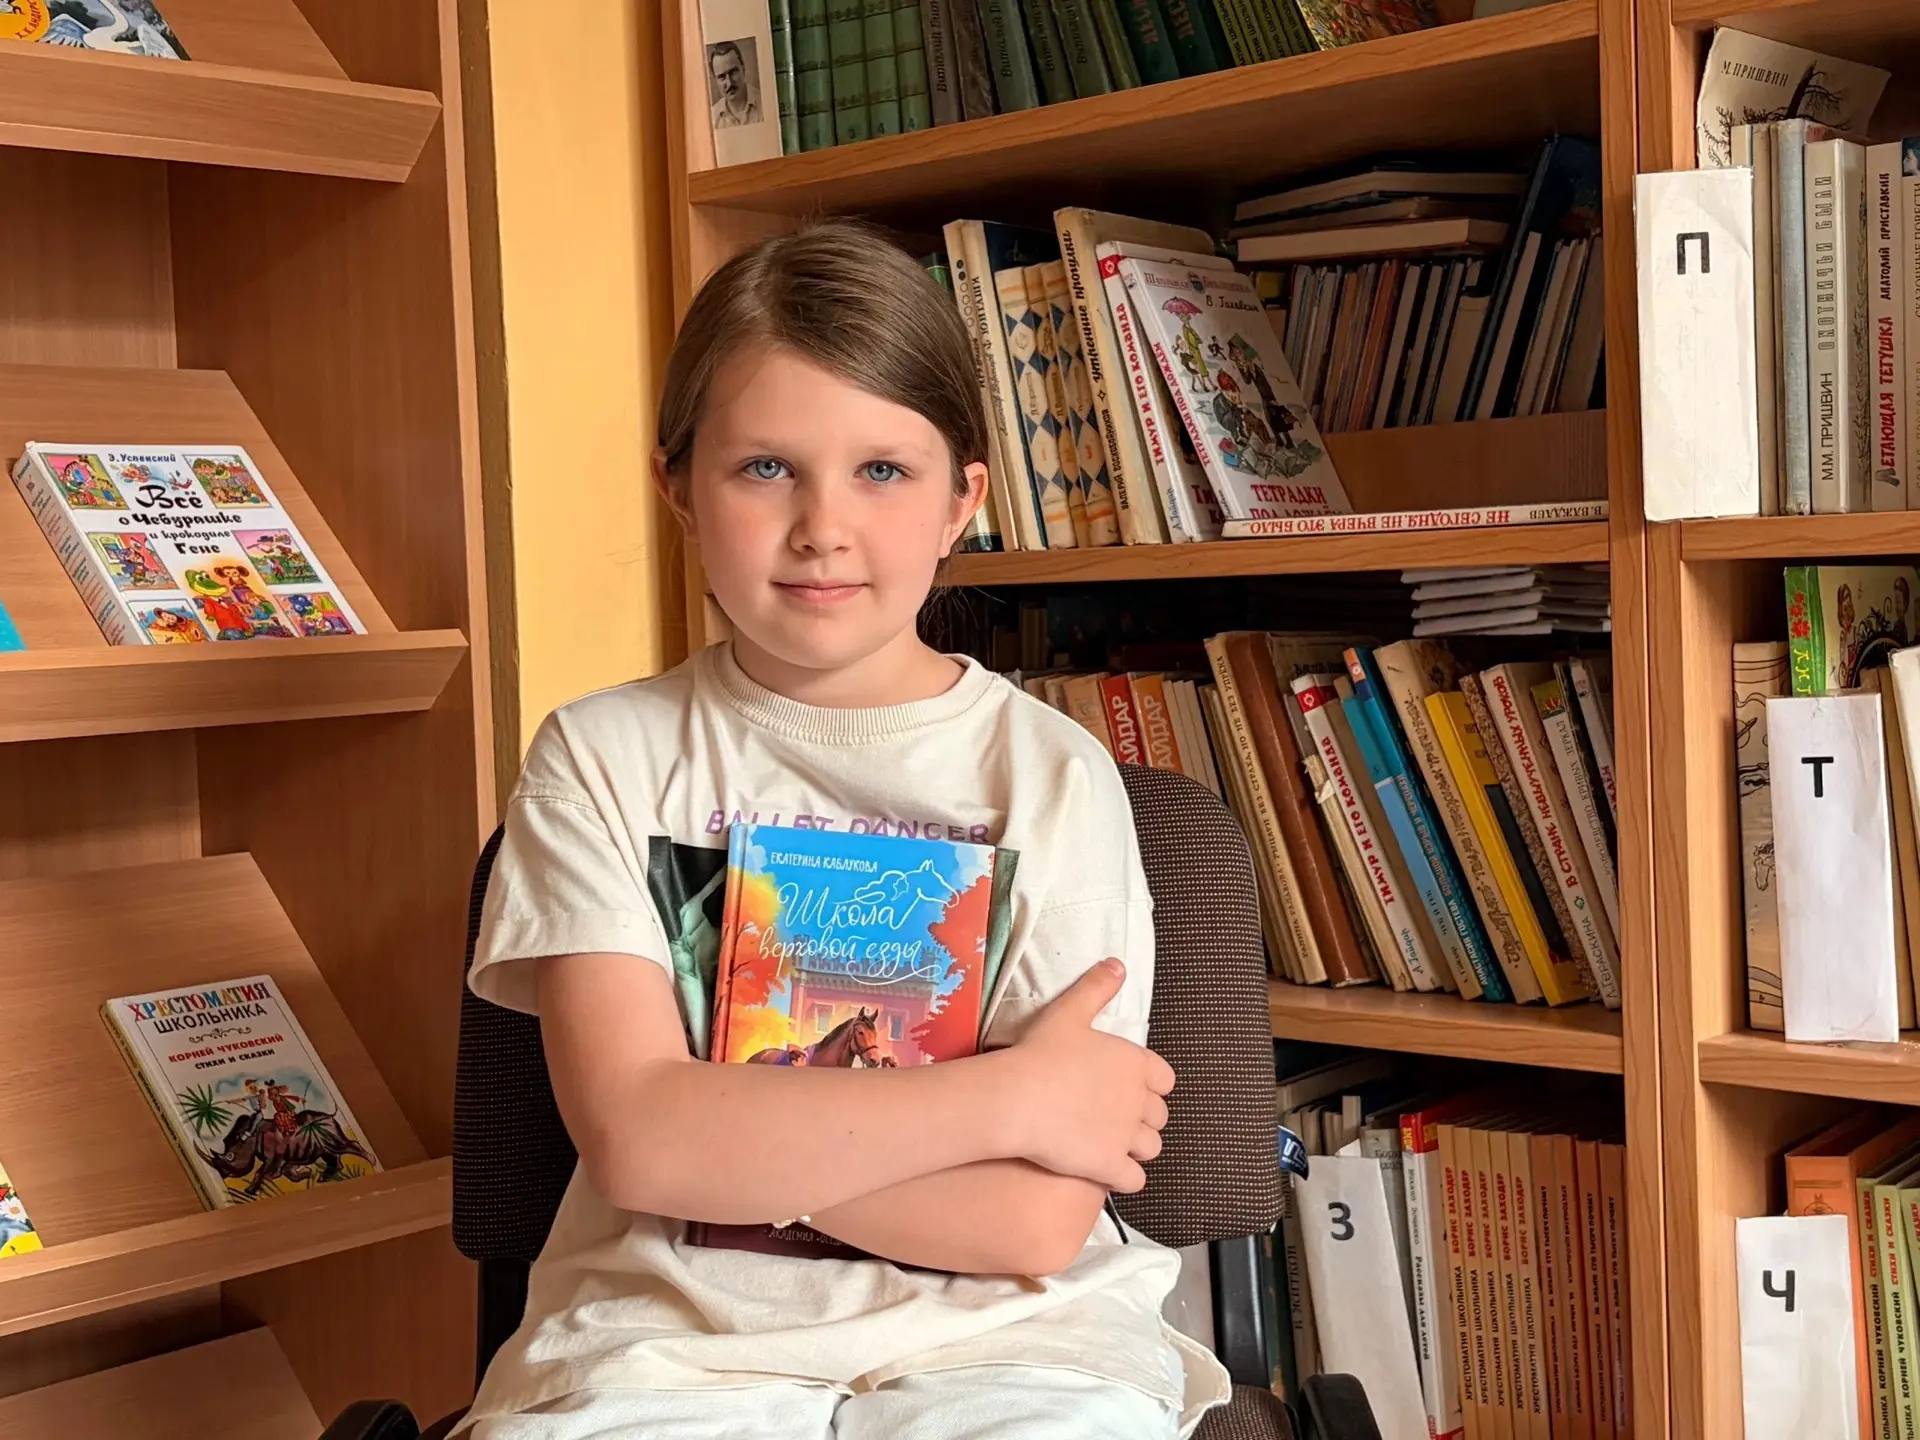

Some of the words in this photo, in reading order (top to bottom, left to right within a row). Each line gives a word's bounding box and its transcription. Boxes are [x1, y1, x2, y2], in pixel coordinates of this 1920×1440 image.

[1814, 177, 1831, 229] БЫЛИ
[1879, 173, 1890, 239] ПРИСТАВКИН
[1677, 231, 1710, 275] П
[1878, 247, 1891, 300] АНАТОЛИЙ
[1816, 243, 1835, 350] ОХОТНИЧЬИ
[1135, 375, 1147, 399] ЕГО
[1141, 402, 1151, 413] И
[1174, 389, 1187, 411] ПОД
[1820, 373, 1833, 446] ПРИШВИН
[1145, 417, 1164, 465] ТИМУР
[1181, 413, 1210, 466] ТЕТРАДКИ
[136, 484, 204, 509] Всё
[1113, 474, 1129, 510] ВАЛЕРИЙ
[1250, 485, 1327, 504] ТЕТРАДКИ
[134, 513, 243, 527] Чебурашке
[149, 531, 158, 540] и
[162, 528, 231, 541] крокодиле
[1295, 519, 1323, 531] ЭТО
[1328, 516, 1376, 529] ВЧЕРА
[1379, 515, 1401, 526] НЕ
[1485, 508, 1511, 519] НЕ
[175, 542, 220, 555] Гене
[1227, 695, 1237, 712] БЕЗ
[1493, 676, 1517, 722] УРОКОВ
[1105, 696, 1139, 765] АЙДАР
[1137, 696, 1173, 769] АЙДАР
[1556, 720, 1574, 756] ЗЕРКАЛ
[1570, 760, 1589, 800] КРИВЫХ
[1801, 756, 1834, 798] Т
[1256, 795, 1266, 814] БЕЗ
[1350, 810, 1367, 835] ЕГО
[849, 817, 989, 843] DANCER
[1362, 838, 1372, 850] И
[1546, 823, 1571, 873] СТРАНЕ
[770, 852, 821, 868] ЕКАТЕРИНА
[823, 856, 878, 873] КАБЛУКОВА
[1368, 855, 1394, 904] ТИМУР
[1565, 875, 1577, 888] В
[777, 882, 902, 930] Школа
[759, 927, 858, 980] верховой
[1463, 936, 1487, 984] АНАСТАСИЯ
[127, 982, 272, 1022] ХРЕСТОМАТИЯ
[153, 1003, 267, 1034] ШКОЛЬНИКА
[169, 1047, 214, 1063] КОРНЕЙ
[217, 1034, 284, 1053] ЧУКОВСКИЙ
[195, 1058, 226, 1070] СТИХИ
[239, 1049, 275, 1061] СКАЗКИ
[1445, 1167, 1456, 1213] ЗАХОДЕР
[1461, 1170, 1472, 1217] ЗАХОДЕР
[1478, 1171, 1489, 1218] ЗАХОДЕР
[1496, 1173, 1507, 1220] ЗАХОДЕР
[1515, 1177, 1525, 1224] ЗАХОДЕР
[1450, 1219, 1459, 1253] БОРИС
[1465, 1222, 1476, 1257] БОРИС
[1482, 1223, 1492, 1258] БОРИС
[1501, 1226, 1510, 1261] БОРИС
[1519, 1230, 1529, 1265] БОРИС
[1415, 1256, 1424, 1305] Рассказы
[1455, 1266, 1466, 1327] ШКОЛЬНИКА
[1470, 1269, 1482, 1330] ШКОЛЬНИКА
[1487, 1271, 1498, 1332] ШКОЛЬНИКА
[1763, 1270, 1795, 1312] Ч
[1506, 1273, 1517, 1335] ШКОЛЬНИКА
[1523, 1277, 1535, 1339] ШКОЛЬНИКА
[1871, 1284, 1882, 1344] ЧУКОВСКИЙ
[1892, 1292, 1904, 1353] ЧУКОВСКИЙ
[1460, 1331, 1472, 1400] ХРЕСТОМАТИЯ
[1476, 1335, 1488, 1403] ХРЕСТОМАТИЯ
[1493, 1337, 1504, 1405] ХРЕСТОМАТИЯ
[1511, 1339, 1523, 1408] ХРЕСТОМАТИЯ
[1528, 1344, 1540, 1413] ХРЕСТОМАТИЯ
[1876, 1349, 1886, 1389] КОРНЕЙ
[1898, 1358, 1909, 1398] КОРНЕЙ
